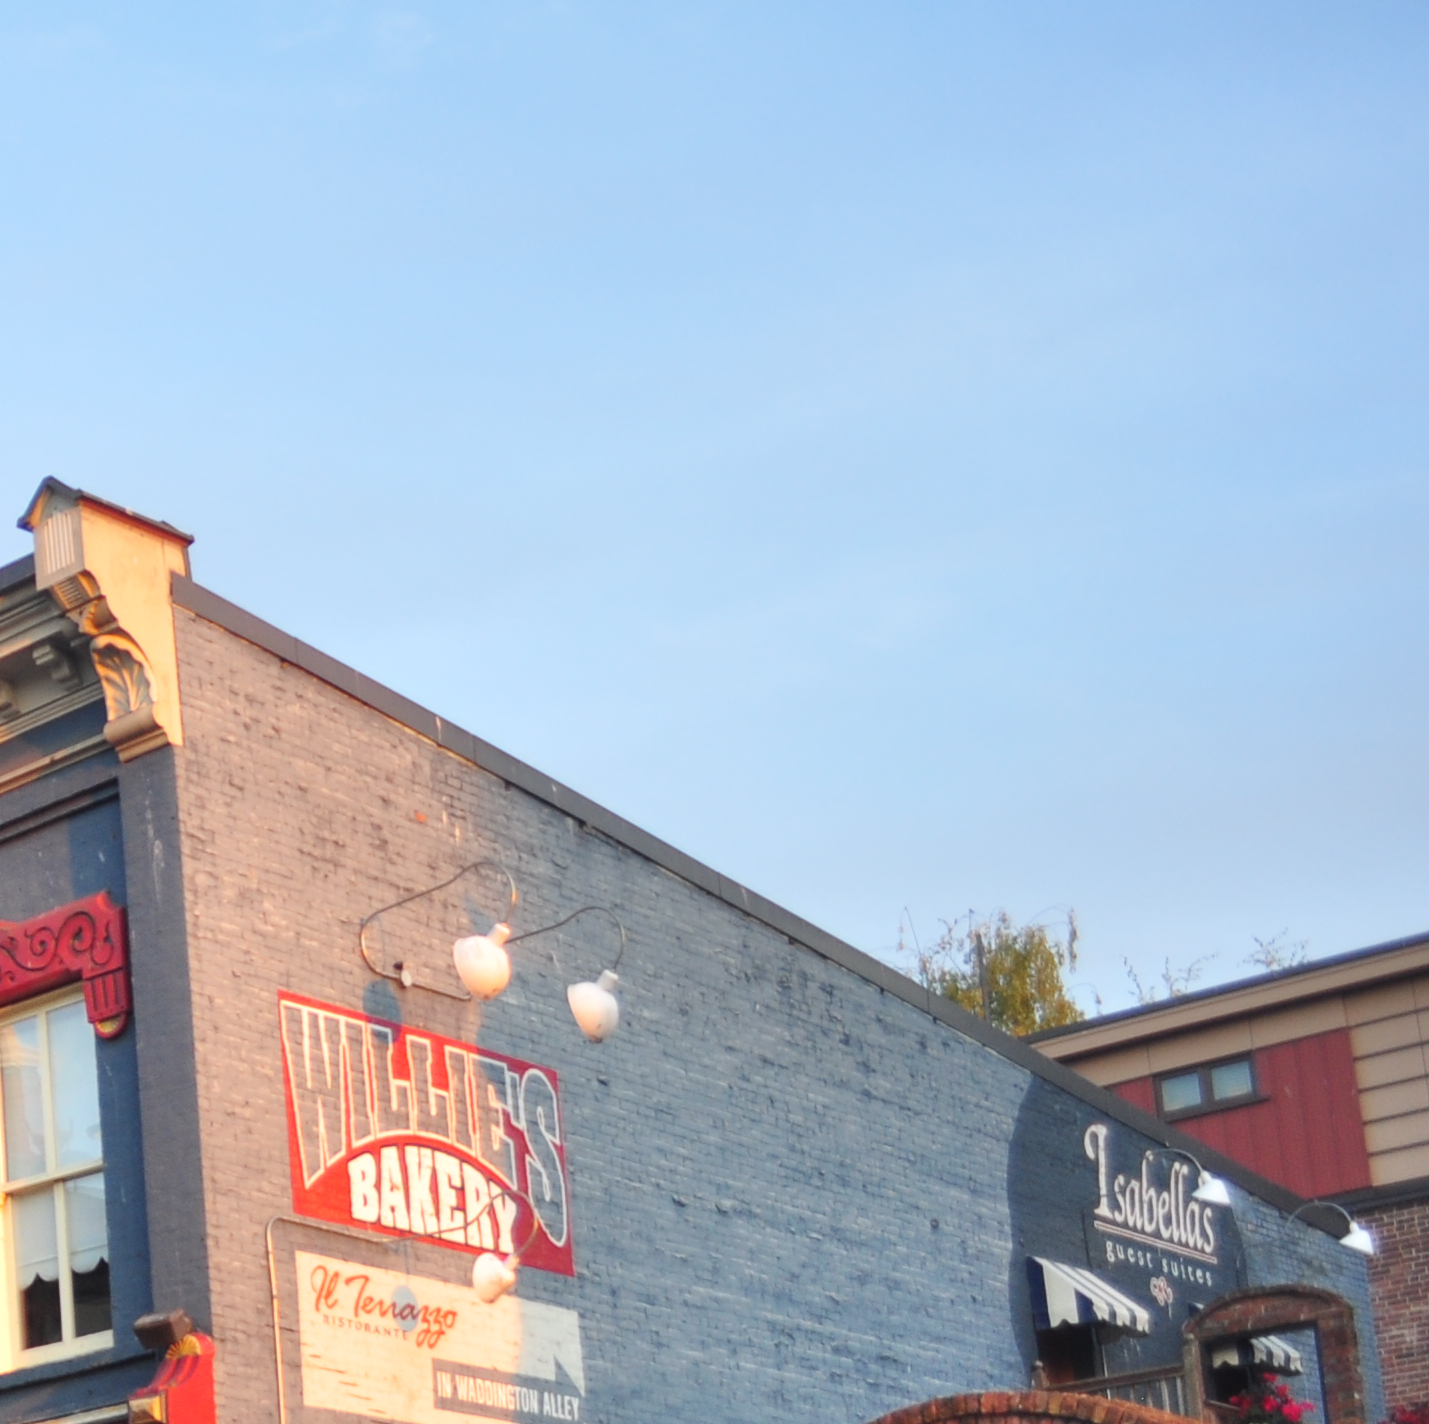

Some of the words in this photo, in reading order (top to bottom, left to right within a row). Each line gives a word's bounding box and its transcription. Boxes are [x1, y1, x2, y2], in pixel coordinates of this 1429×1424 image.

[279, 999, 568, 1247] WILLIE'S
[347, 1142, 517, 1255] BAKERY
[1106, 1240, 1154, 1268] guest
[1162, 1258, 1212, 1287] suites
[311, 1265, 339, 1312] Il
[345, 1275, 458, 1349] Terrazzo
[322, 1314, 408, 1341] RISTORANTE
[436, 1371, 452, 1398] IN
[455, 1374, 538, 1413] WADDINGTON
[543, 1391, 579, 1421] ALLEY
